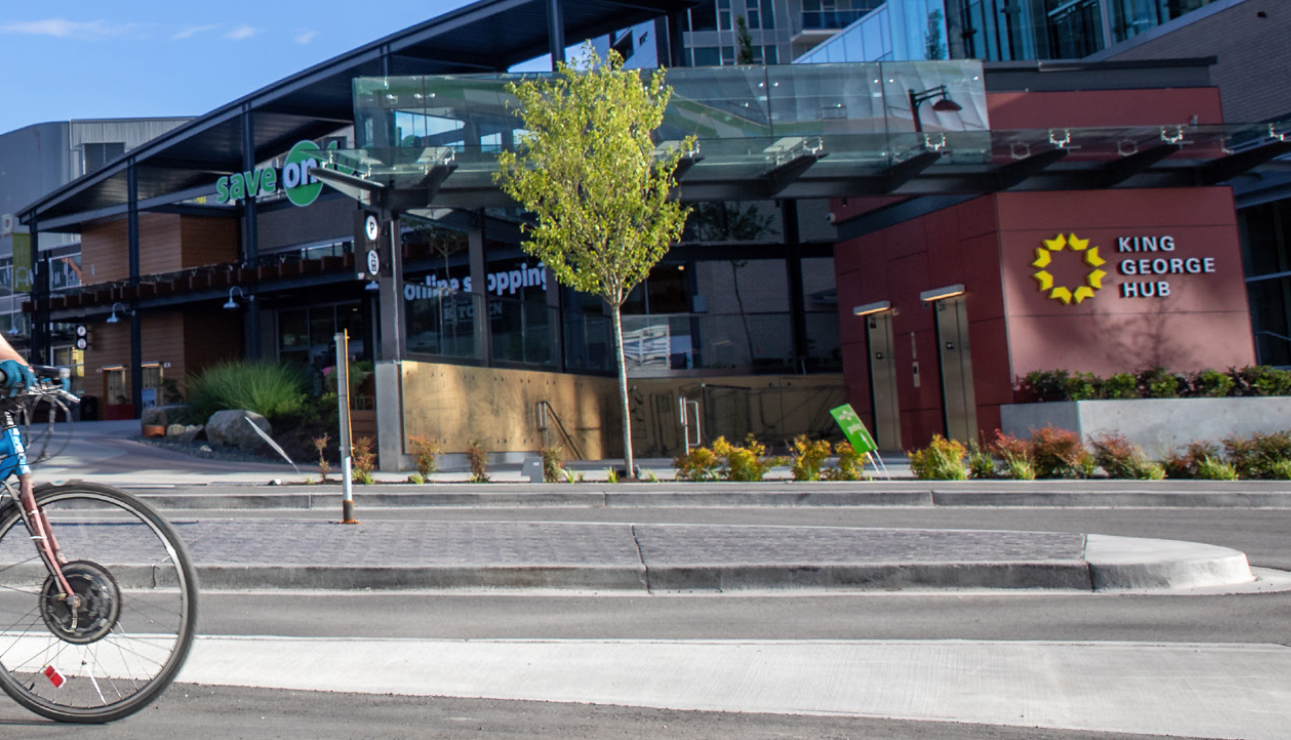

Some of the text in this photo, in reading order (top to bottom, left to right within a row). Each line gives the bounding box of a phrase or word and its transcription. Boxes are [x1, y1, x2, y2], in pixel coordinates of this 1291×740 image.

[216, 167, 277, 203] save
[283, 157, 318, 189] on
[1118, 235, 1176, 252] KING
[1121, 257, 1216, 275] GEORGE
[1123, 281, 1171, 297] HUB
